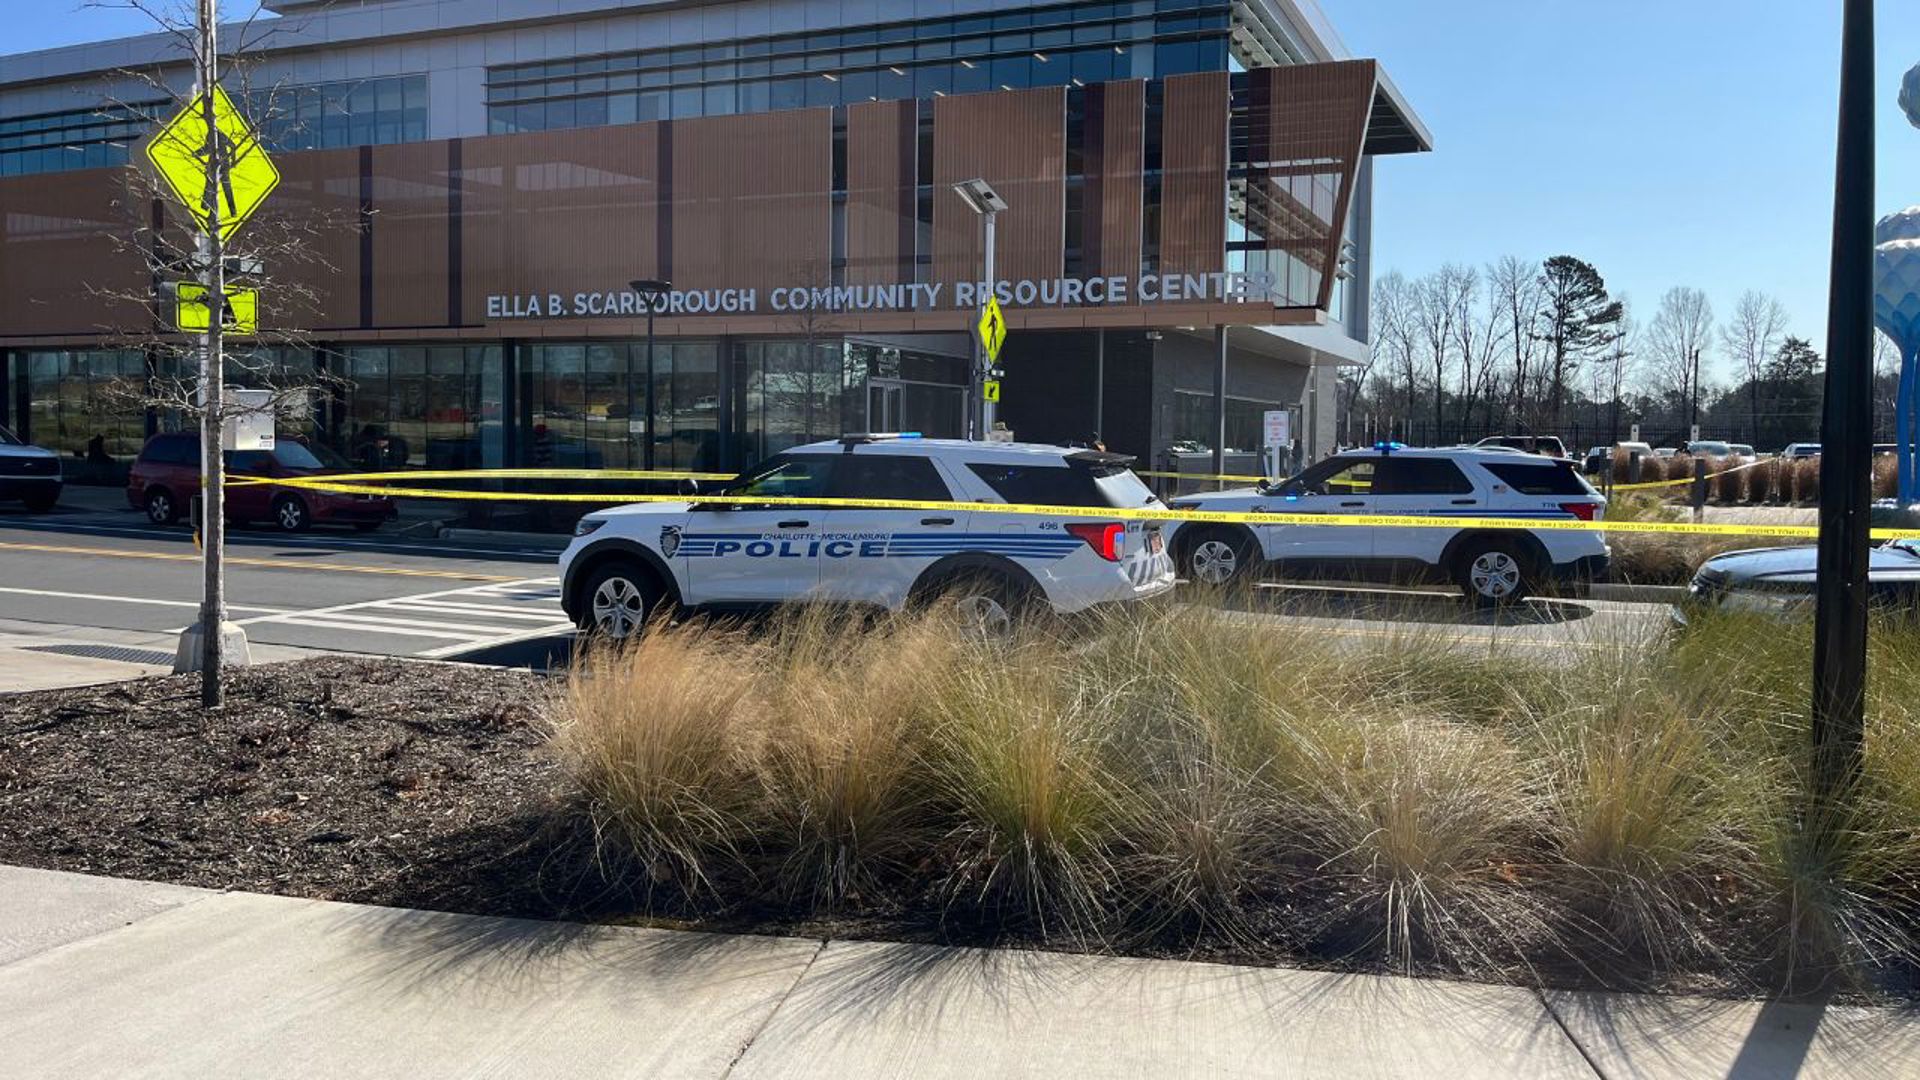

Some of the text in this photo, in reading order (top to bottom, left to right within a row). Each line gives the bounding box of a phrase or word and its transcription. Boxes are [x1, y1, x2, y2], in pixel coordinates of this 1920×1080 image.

[487, 295, 541, 318] ELLA
[548, 293, 568, 315] B.
[573, 288, 756, 314] SCARBOROUGH
[770, 283, 942, 310] COMMUNITY
[1137, 271, 1275, 301] CENTER
[1039, 522, 1058, 530] 496
[714, 541, 888, 558] POLICE
